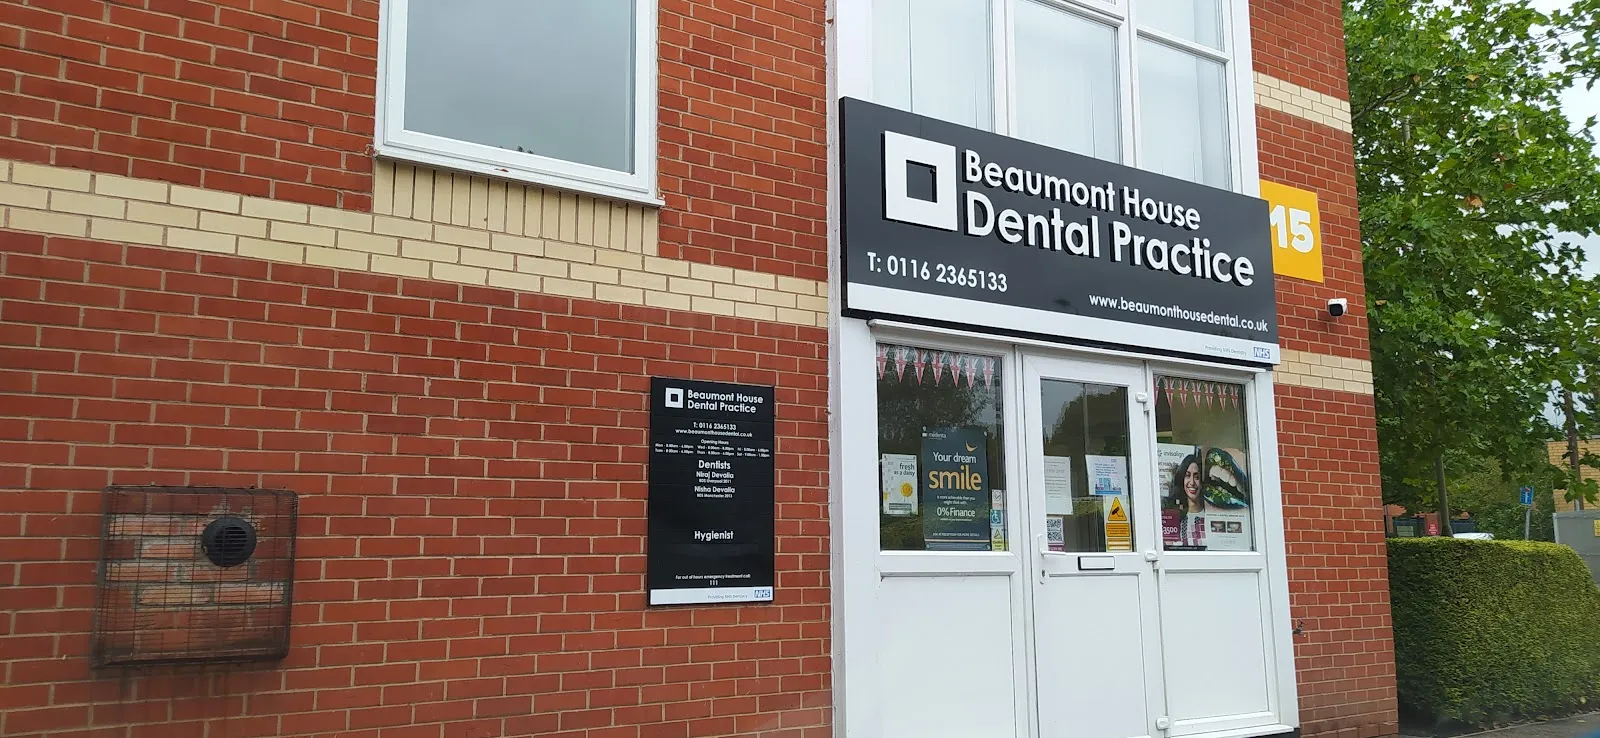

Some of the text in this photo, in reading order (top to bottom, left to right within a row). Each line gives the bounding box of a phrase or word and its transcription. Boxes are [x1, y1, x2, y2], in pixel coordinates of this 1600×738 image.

[965, 150, 1201, 230] Beaumont House
[1270, 204, 1315, 253] 15
[964, 193, 1256, 288] Dental Practice
[867, 251, 1009, 293] T: 0116 2365133
[1089, 293, 1269, 333] www.beaumonthousedental.co.uk
[1253, 347, 1271, 359] NHS
[688, 389, 764, 404] Beaumont House
[688, 400, 757, 414] Dental Practice
[699, 422, 713, 430] 0116
[713, 423, 737, 431] 2365133
[675, 428, 753, 438] www.beaumonthousedental.co.uk
[932, 451, 977, 464] Your dream
[698, 460, 731, 470] Dentists
[899, 462, 915, 471] fresh
[696, 471, 734, 480] Niraj Devalia
[904, 470, 916, 478] daisy
[928, 465, 982, 491] smile
[937, 507, 976, 518] 0% Finance
[694, 531, 734, 541] Hygienist
[1162, 526, 1178, 535] 3500
[754, 589, 771, 598] NHS
